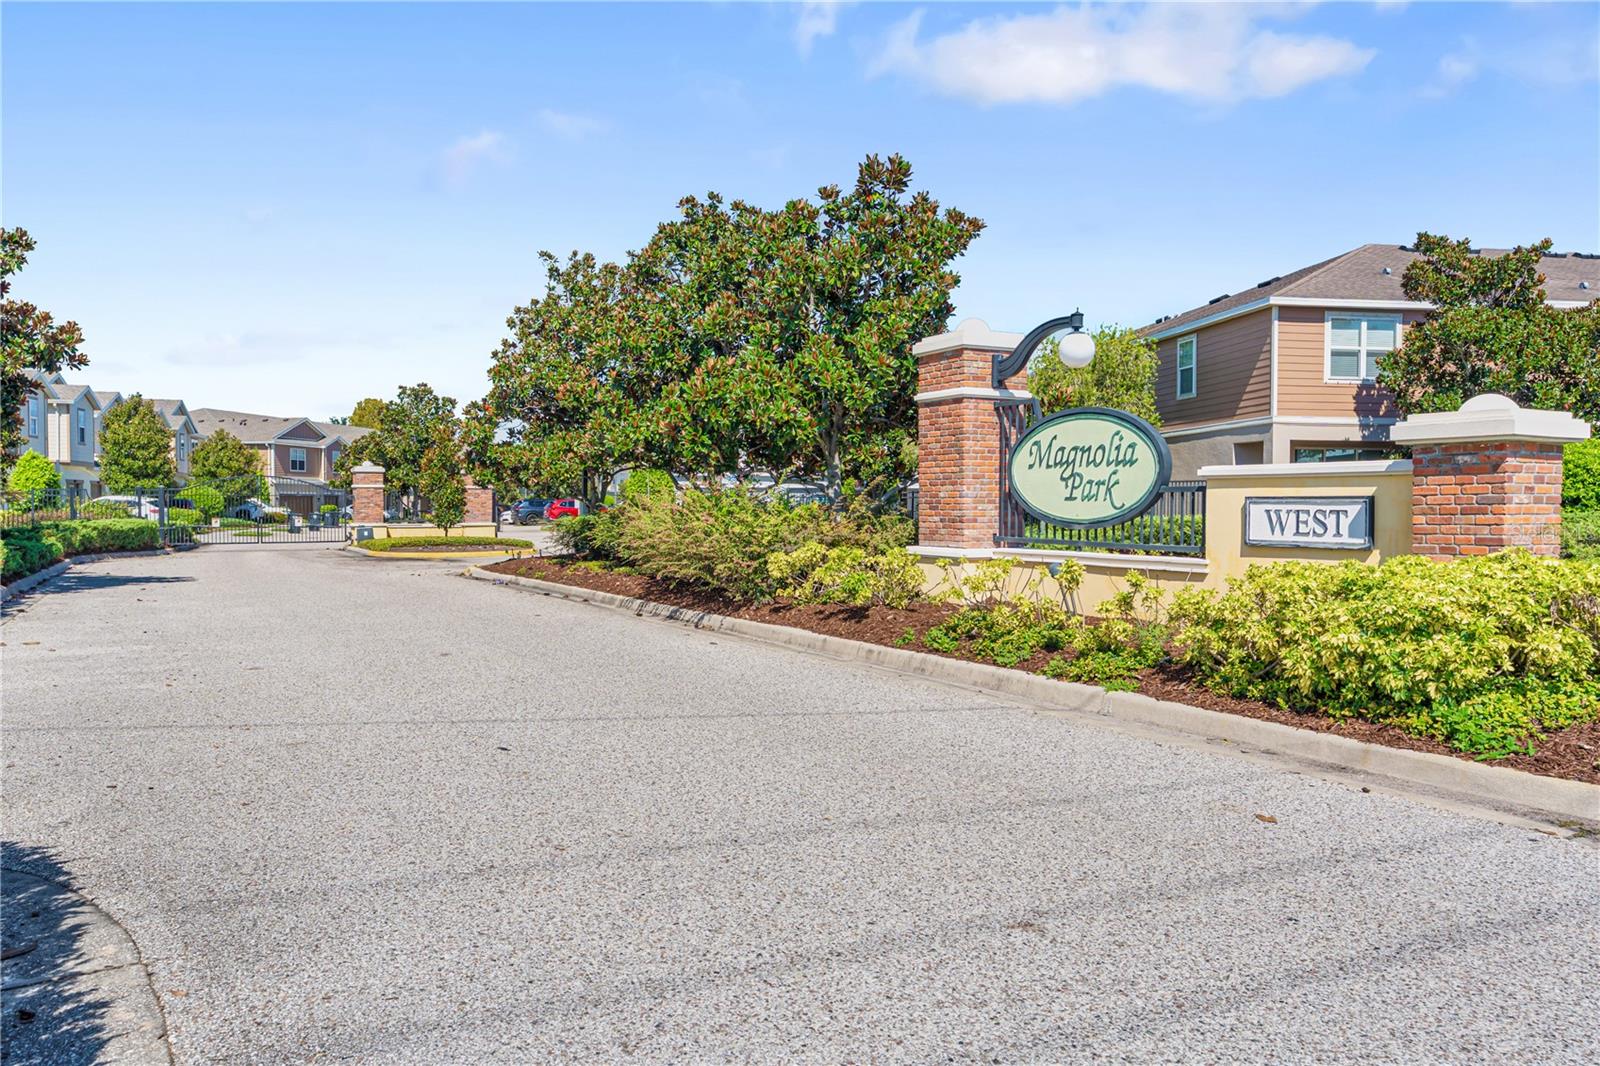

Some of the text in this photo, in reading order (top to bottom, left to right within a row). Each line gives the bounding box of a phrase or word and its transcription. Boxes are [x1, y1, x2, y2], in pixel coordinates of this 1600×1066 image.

[1027, 430, 1139, 482] Magnolia
[1063, 469, 1126, 511] Park
[1264, 509, 1349, 538] WEST
